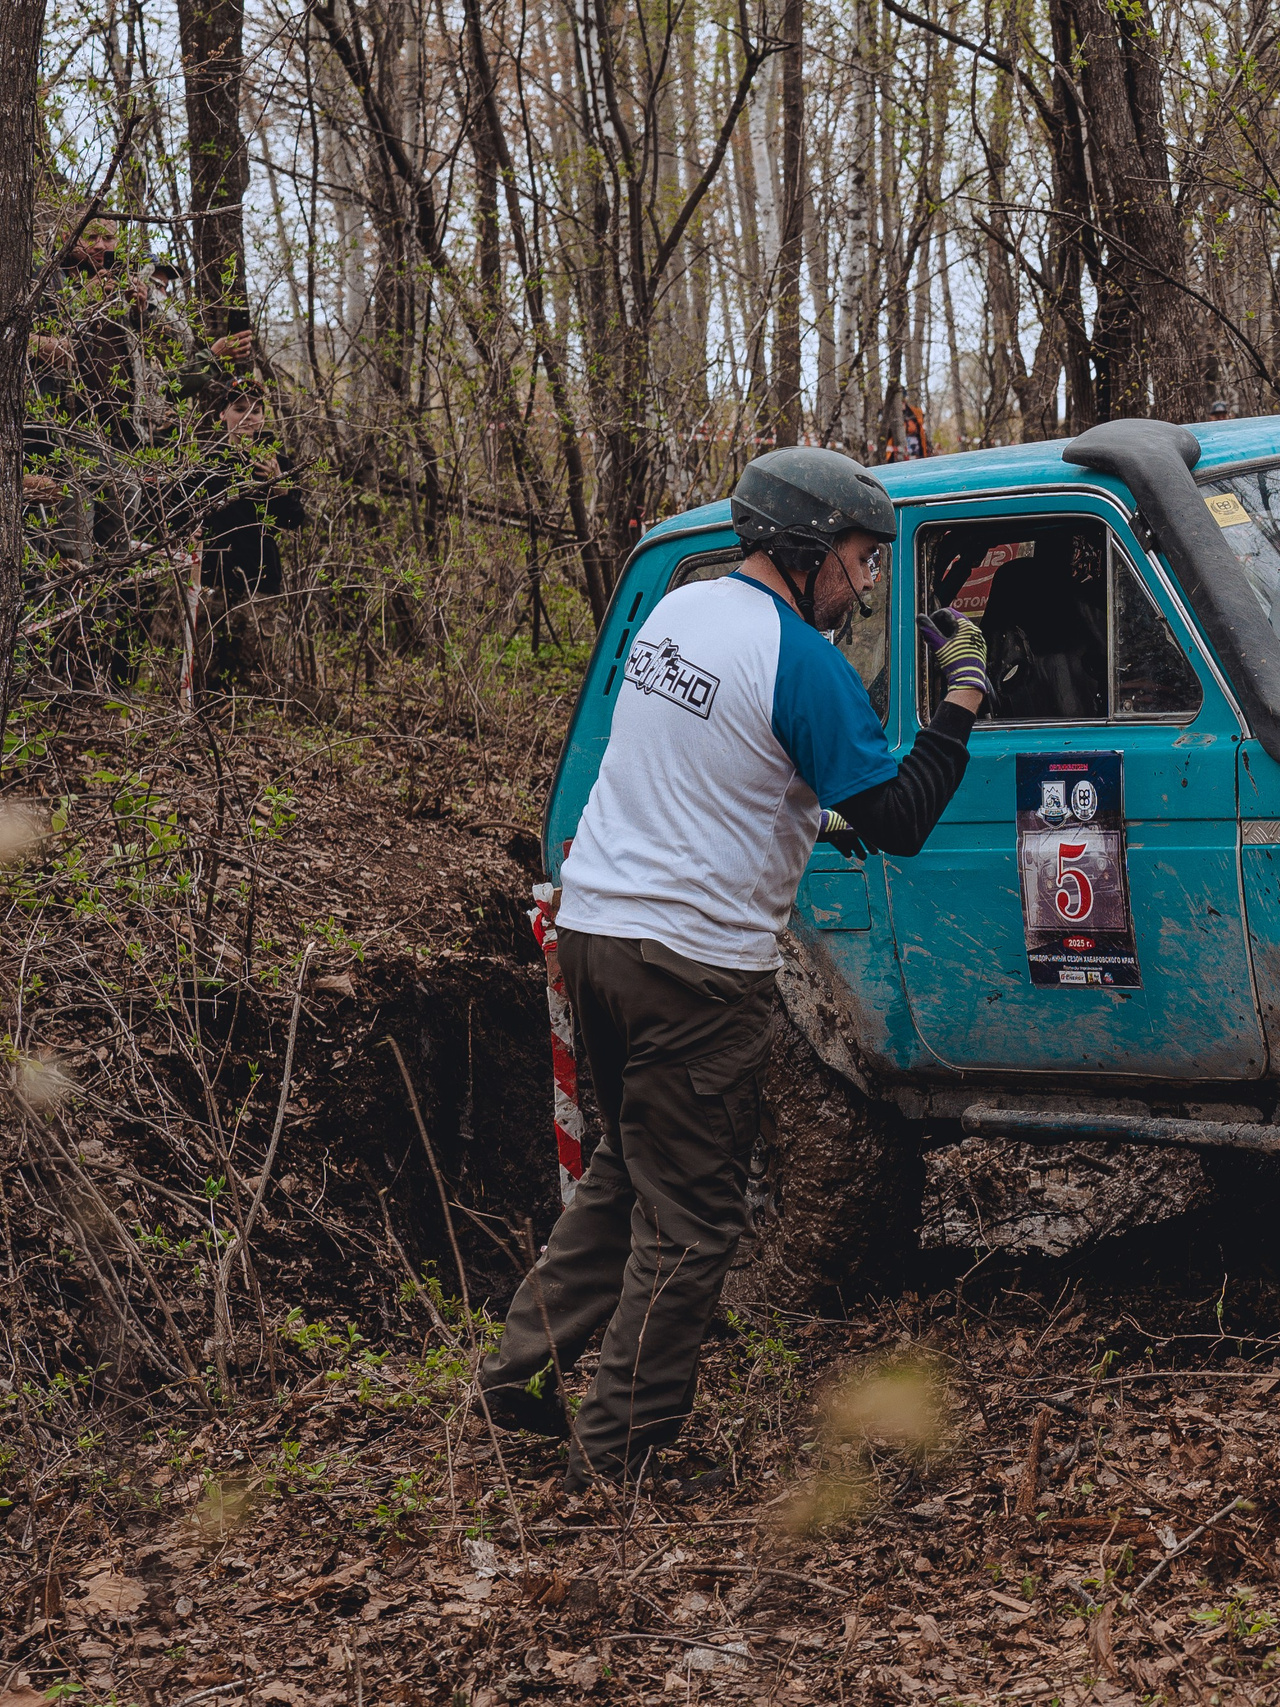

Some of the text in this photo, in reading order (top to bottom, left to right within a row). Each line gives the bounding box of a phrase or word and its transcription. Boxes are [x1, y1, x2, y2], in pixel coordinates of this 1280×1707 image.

[1055, 842, 1094, 922] 5
[1068, 939, 1085, 947] 2025
[1029, 954, 1067, 963] ВНЕДОРЖНЫЙ
[1067, 955, 1083, 963] СЕЗОН
